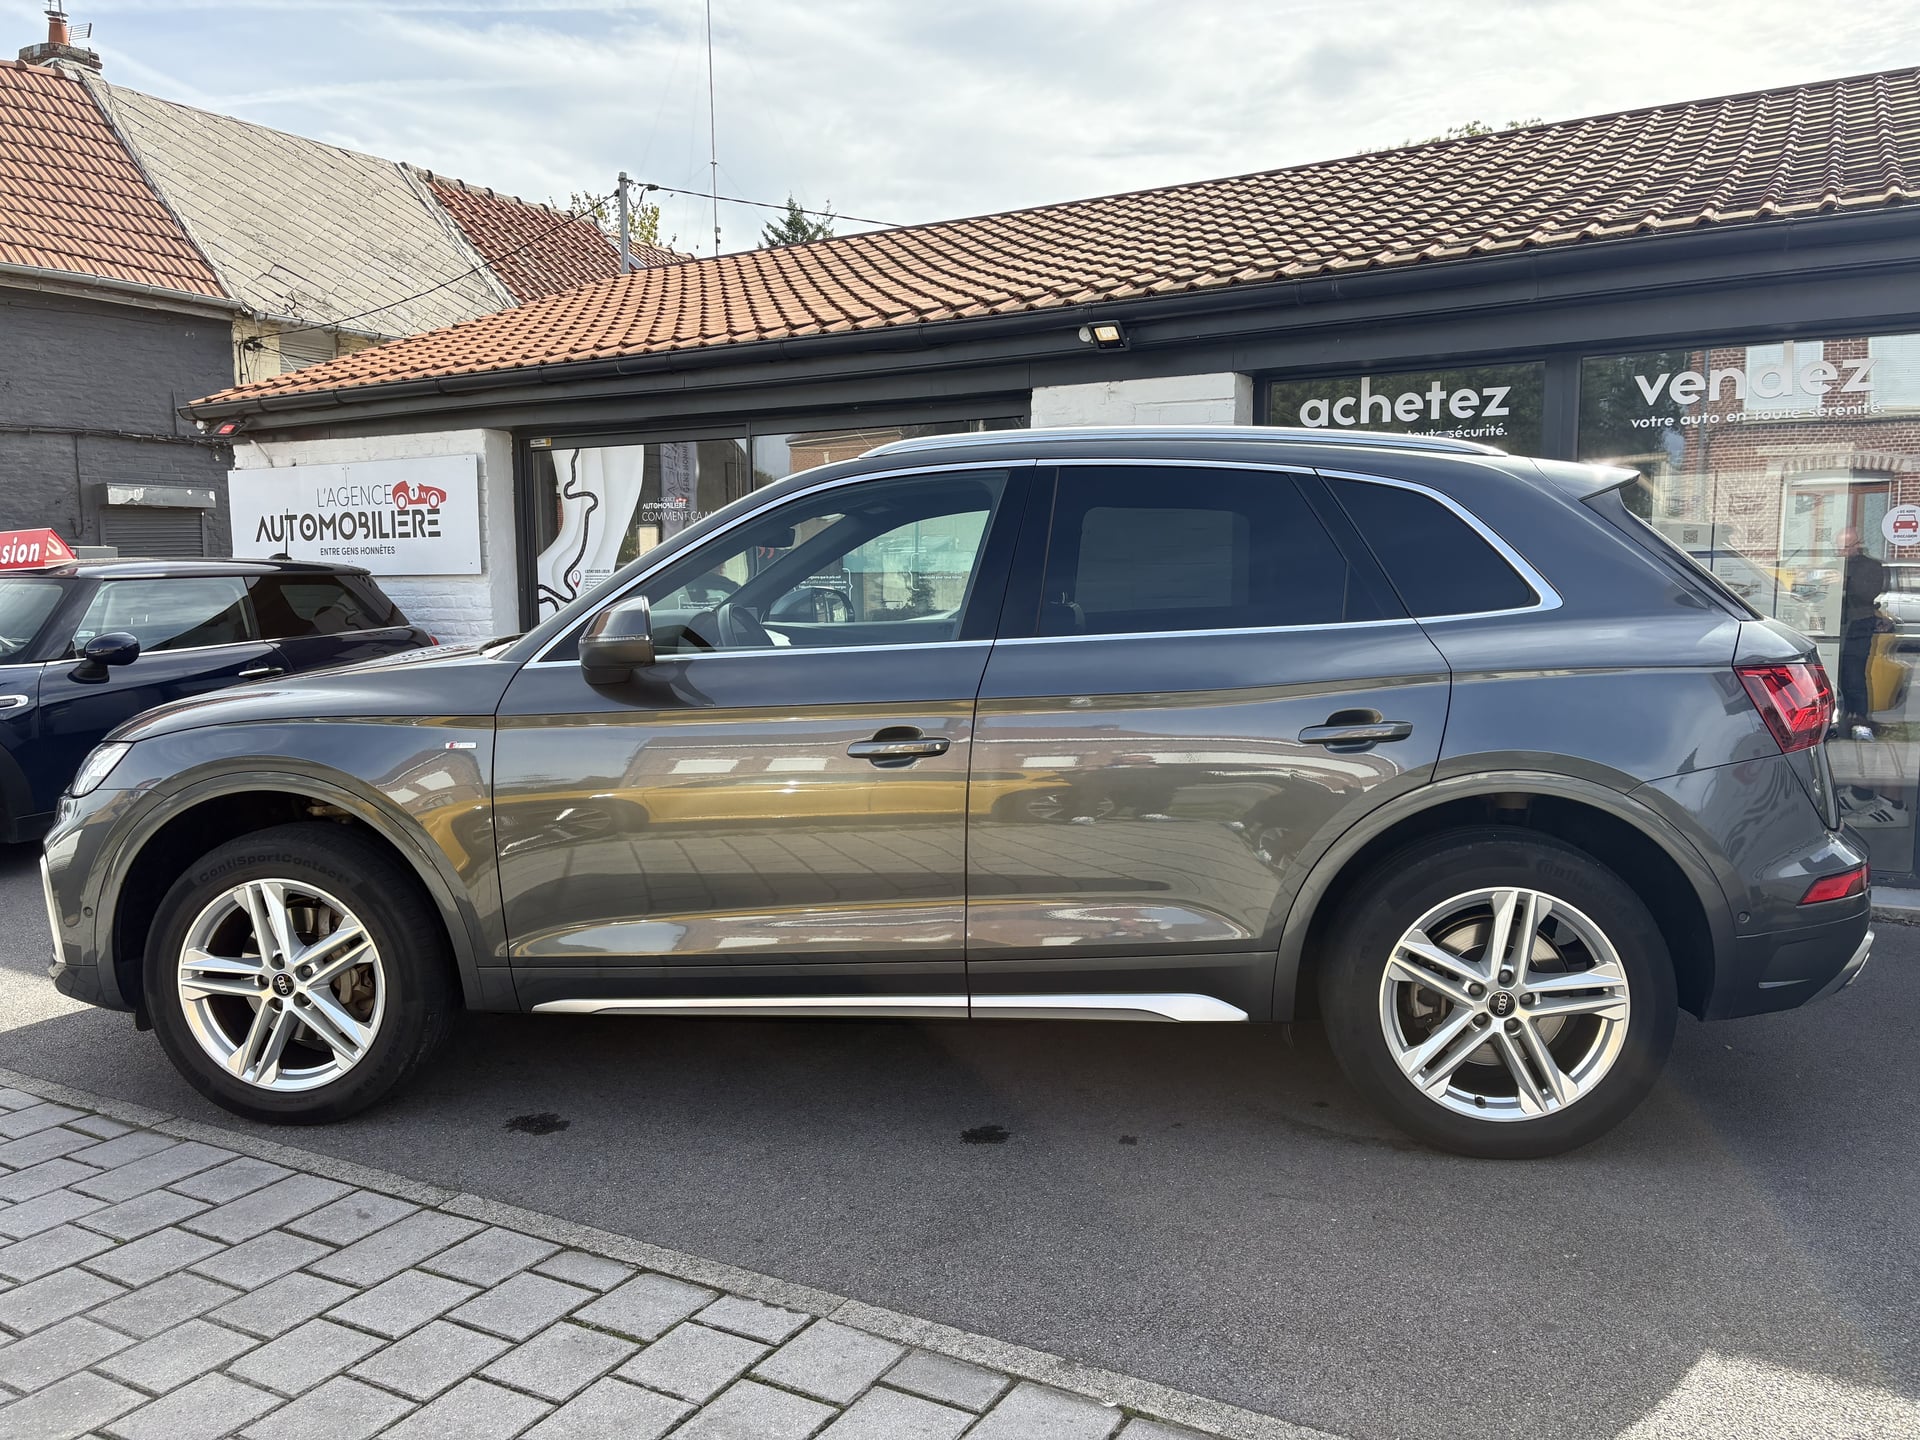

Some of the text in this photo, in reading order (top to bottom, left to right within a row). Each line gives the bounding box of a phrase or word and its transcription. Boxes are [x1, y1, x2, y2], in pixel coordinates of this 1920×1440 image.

[1634, 340, 1879, 406] vendez
[1300, 377, 1511, 427] achetez
[1630, 415, 1674, 428] votre
[1680, 412, 1720, 425] auto
[1726, 412, 1746, 422] en
[1755, 408, 1800, 421] toute
[1448, 422, 1508, 438] sécurité.
[316, 484, 394, 507] L'AGENCE
[641, 511, 688, 522] COMMENT
[320, 544, 396, 556] ENTRE GENS HONNÊTES
